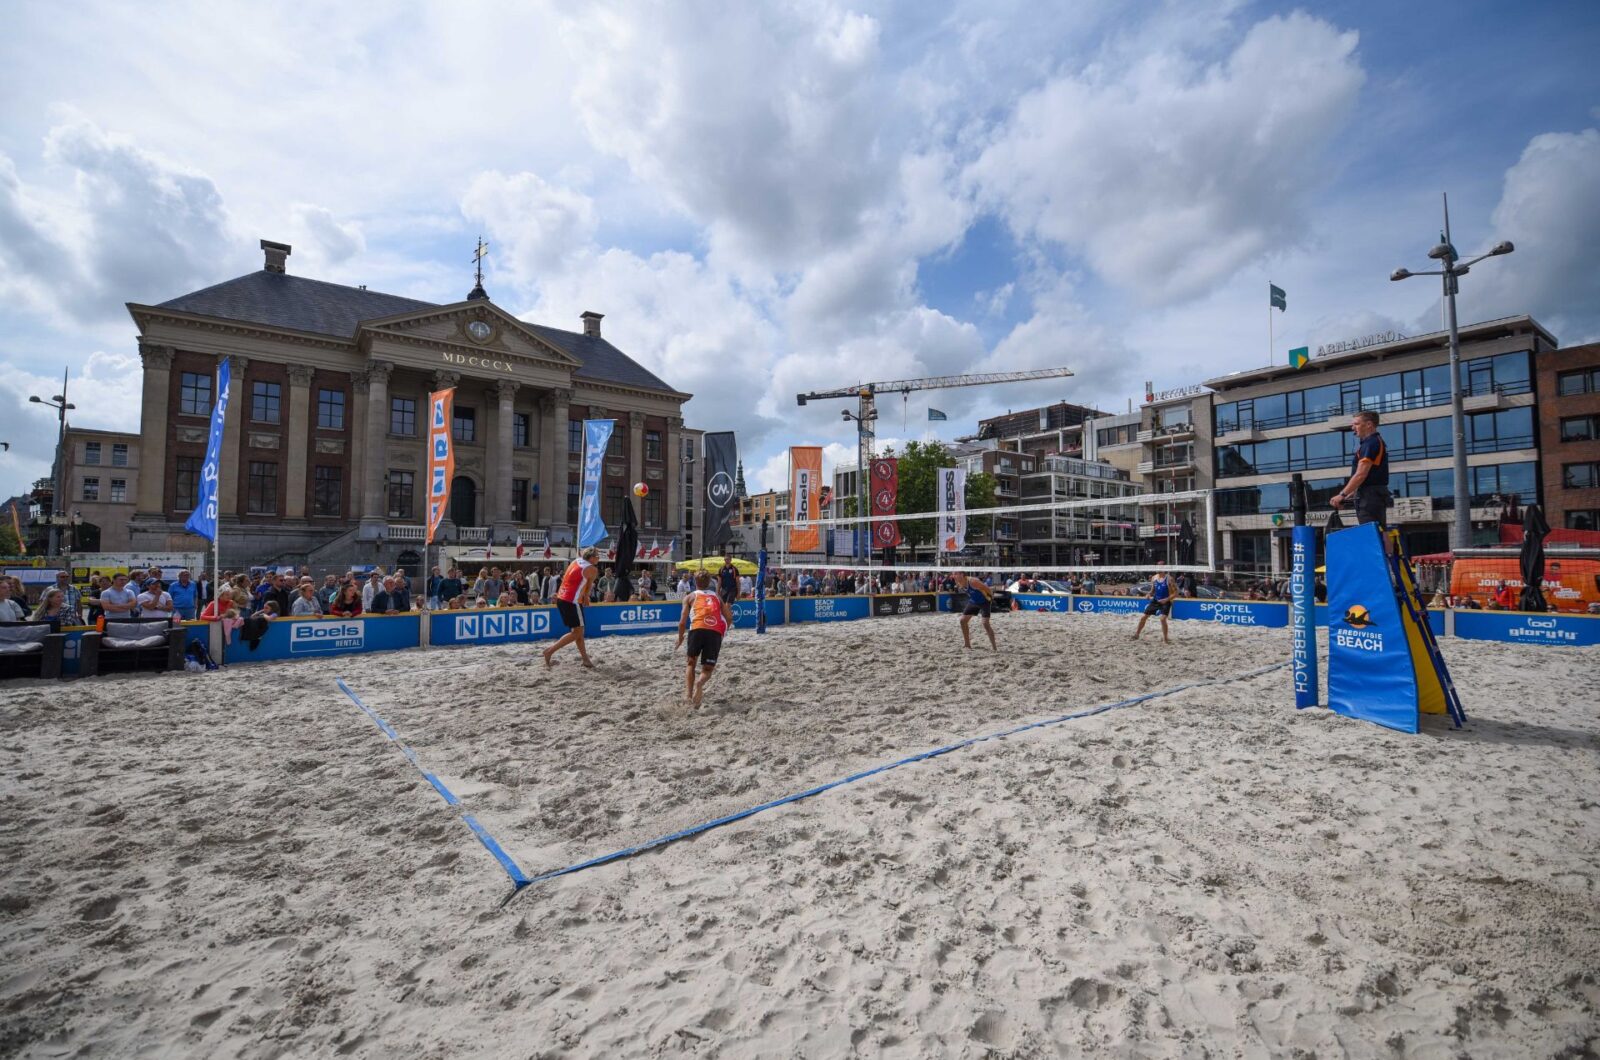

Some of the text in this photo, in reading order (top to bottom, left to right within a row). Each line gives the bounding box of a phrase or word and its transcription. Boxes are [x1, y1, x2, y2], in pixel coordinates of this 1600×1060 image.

[442, 352, 513, 372] MDCCCX
[1097, 600, 1140, 608] LOUWMAN
[1200, 603, 1252, 614] SPORTEL
[814, 610, 848, 618] NEDERLAND
[1214, 613, 1256, 624] OPTIEK
[1292, 542, 1308, 693] #EREDIVISIEBEACH
[296, 625, 359, 639] Boels
[1337, 628, 1383, 640] EREDIVISIE
[335, 640, 361, 648] RENTAL
[1337, 636, 1383, 652] BEACH
